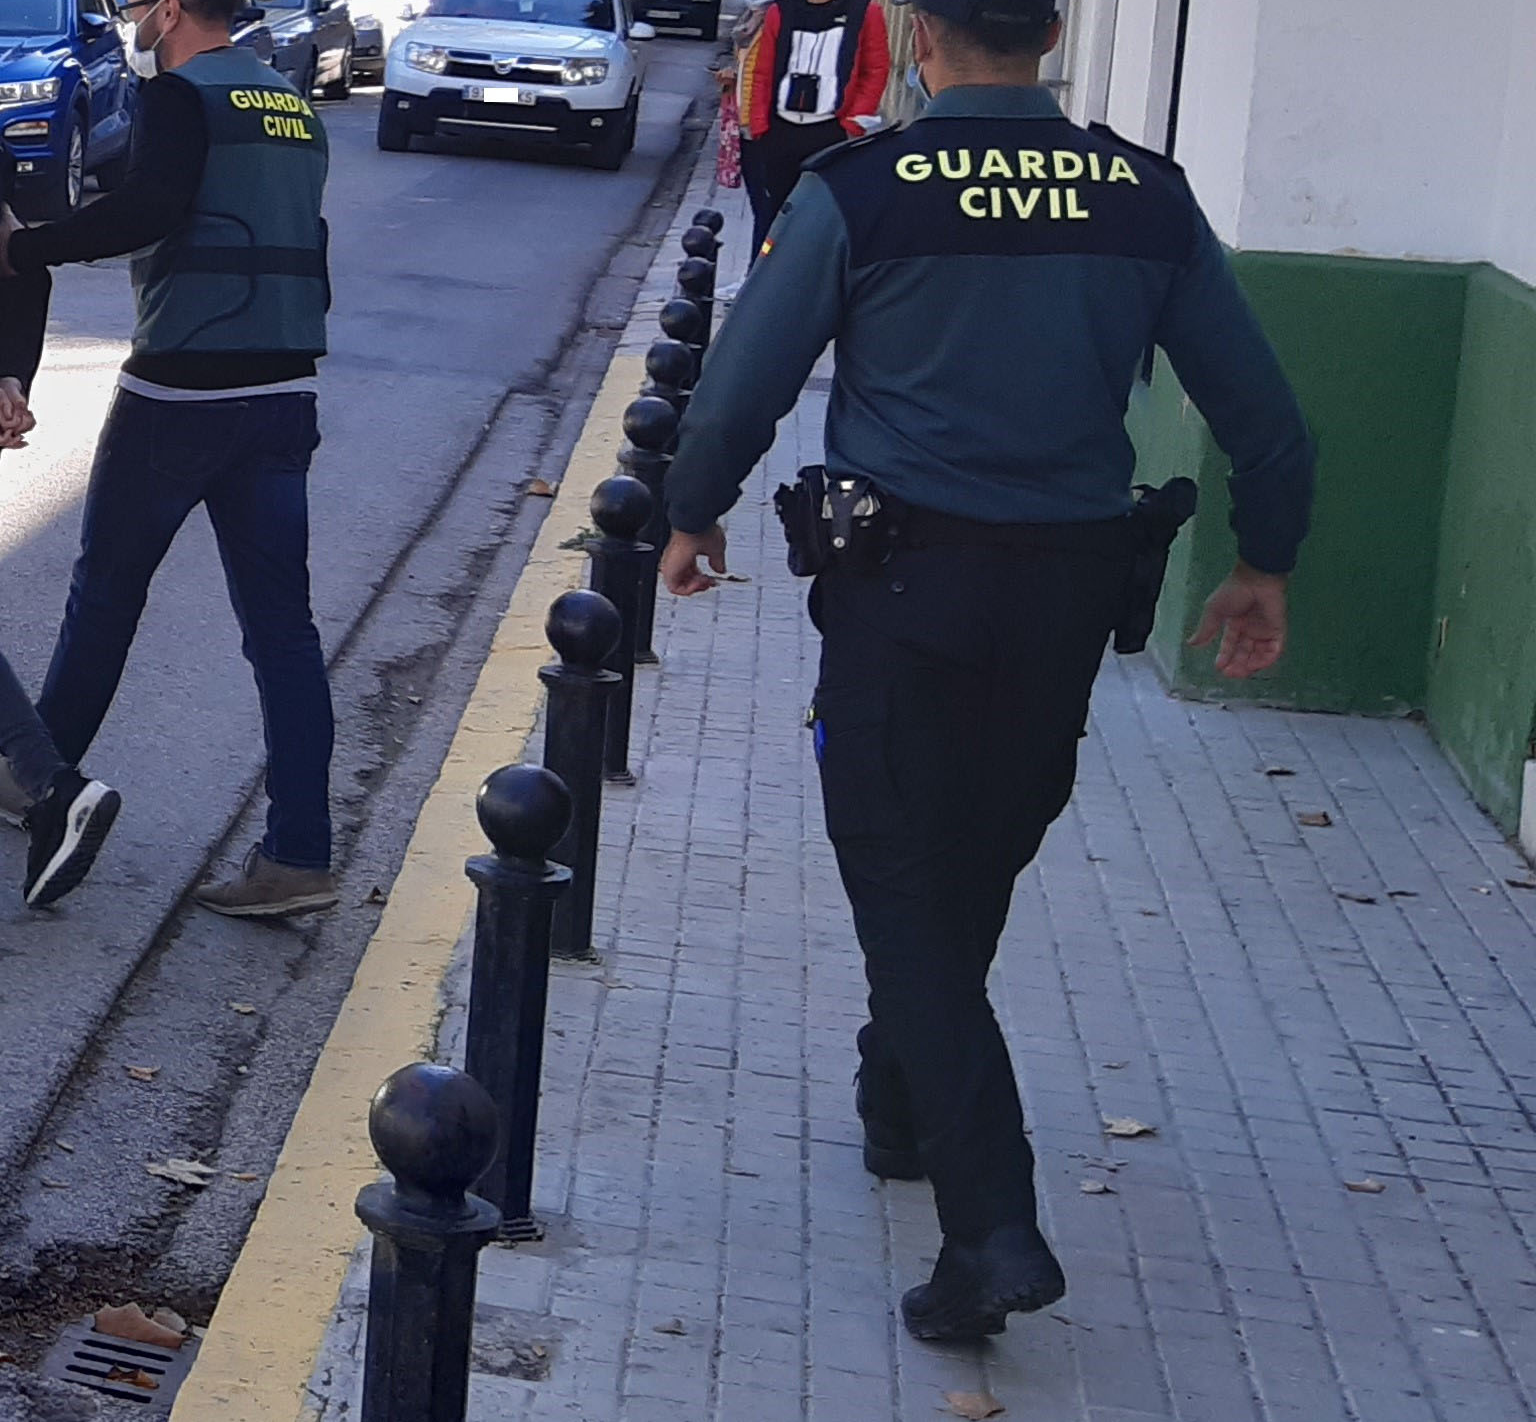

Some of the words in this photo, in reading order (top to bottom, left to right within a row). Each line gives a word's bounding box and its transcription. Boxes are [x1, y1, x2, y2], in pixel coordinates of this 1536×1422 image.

[263, 115, 313, 140] CIVIL
[896, 149, 1140, 185] GUARDIA
[959, 187, 1089, 219] CIVIL
